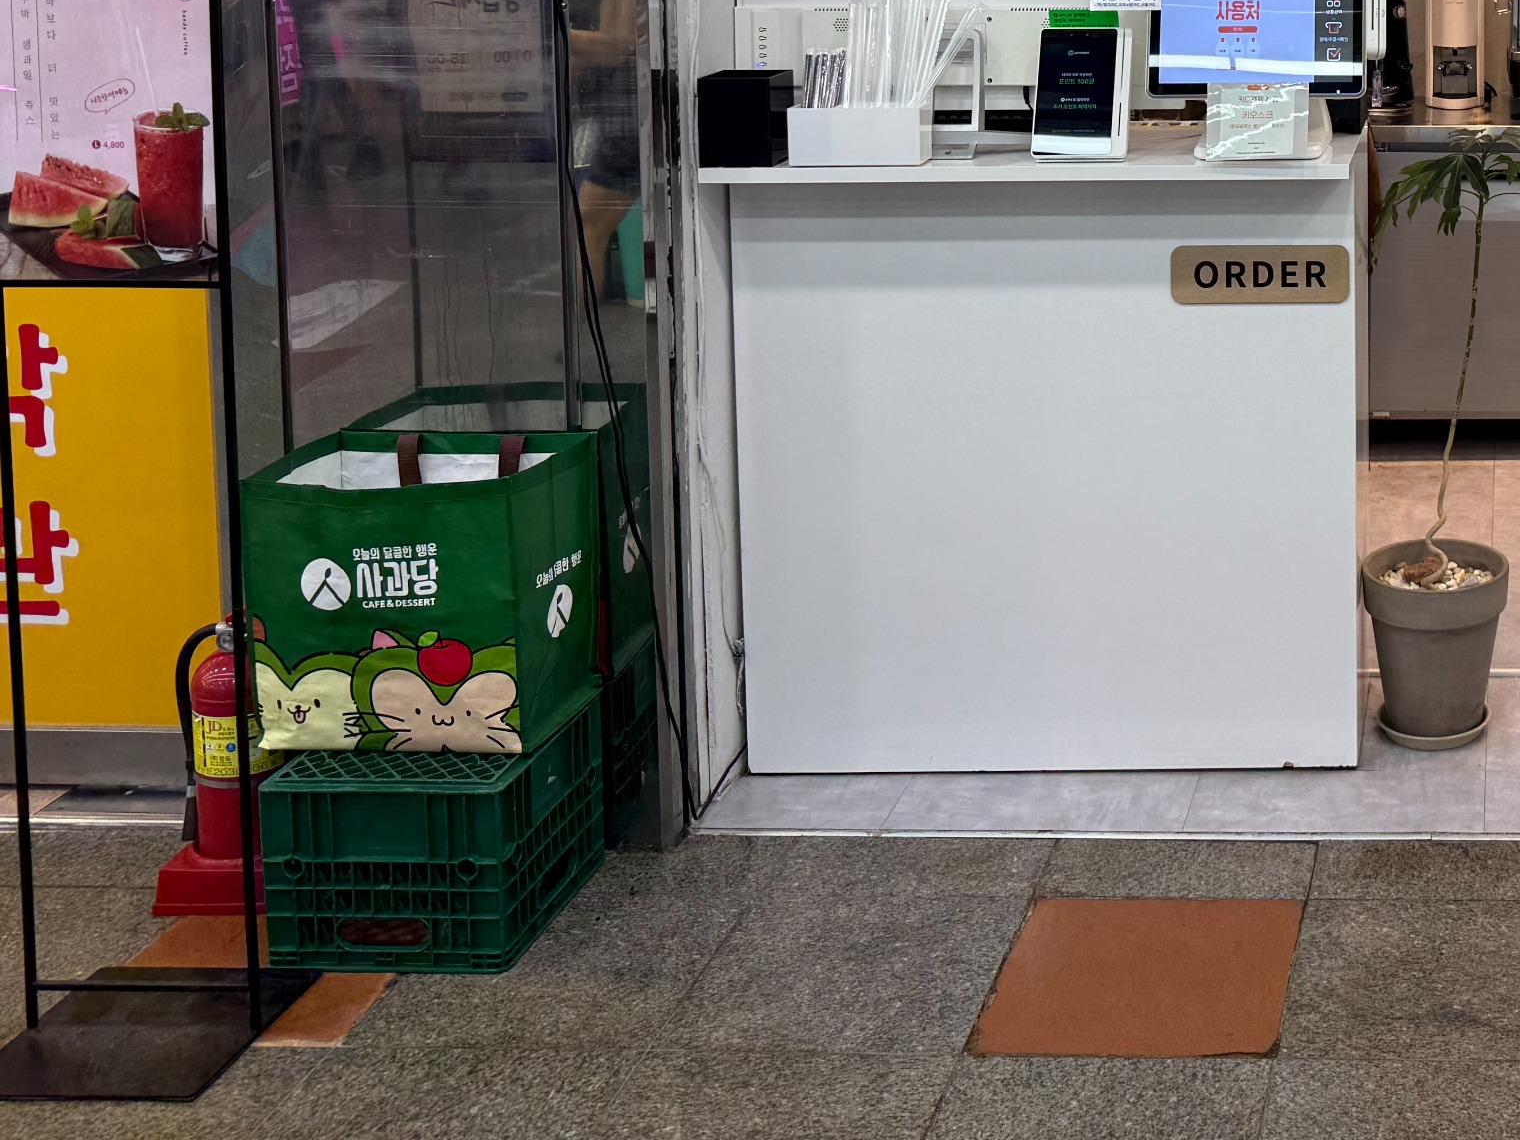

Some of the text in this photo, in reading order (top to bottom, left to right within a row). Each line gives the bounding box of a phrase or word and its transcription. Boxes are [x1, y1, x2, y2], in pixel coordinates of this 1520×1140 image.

[1216, 0, 1260, 20] 사용처
[103, 141, 124, 149] 4,800
[1194, 261, 1326, 288] ORDER
[353, 548, 378, 561] 오늘의
[357, 558, 438, 598] 사과당
